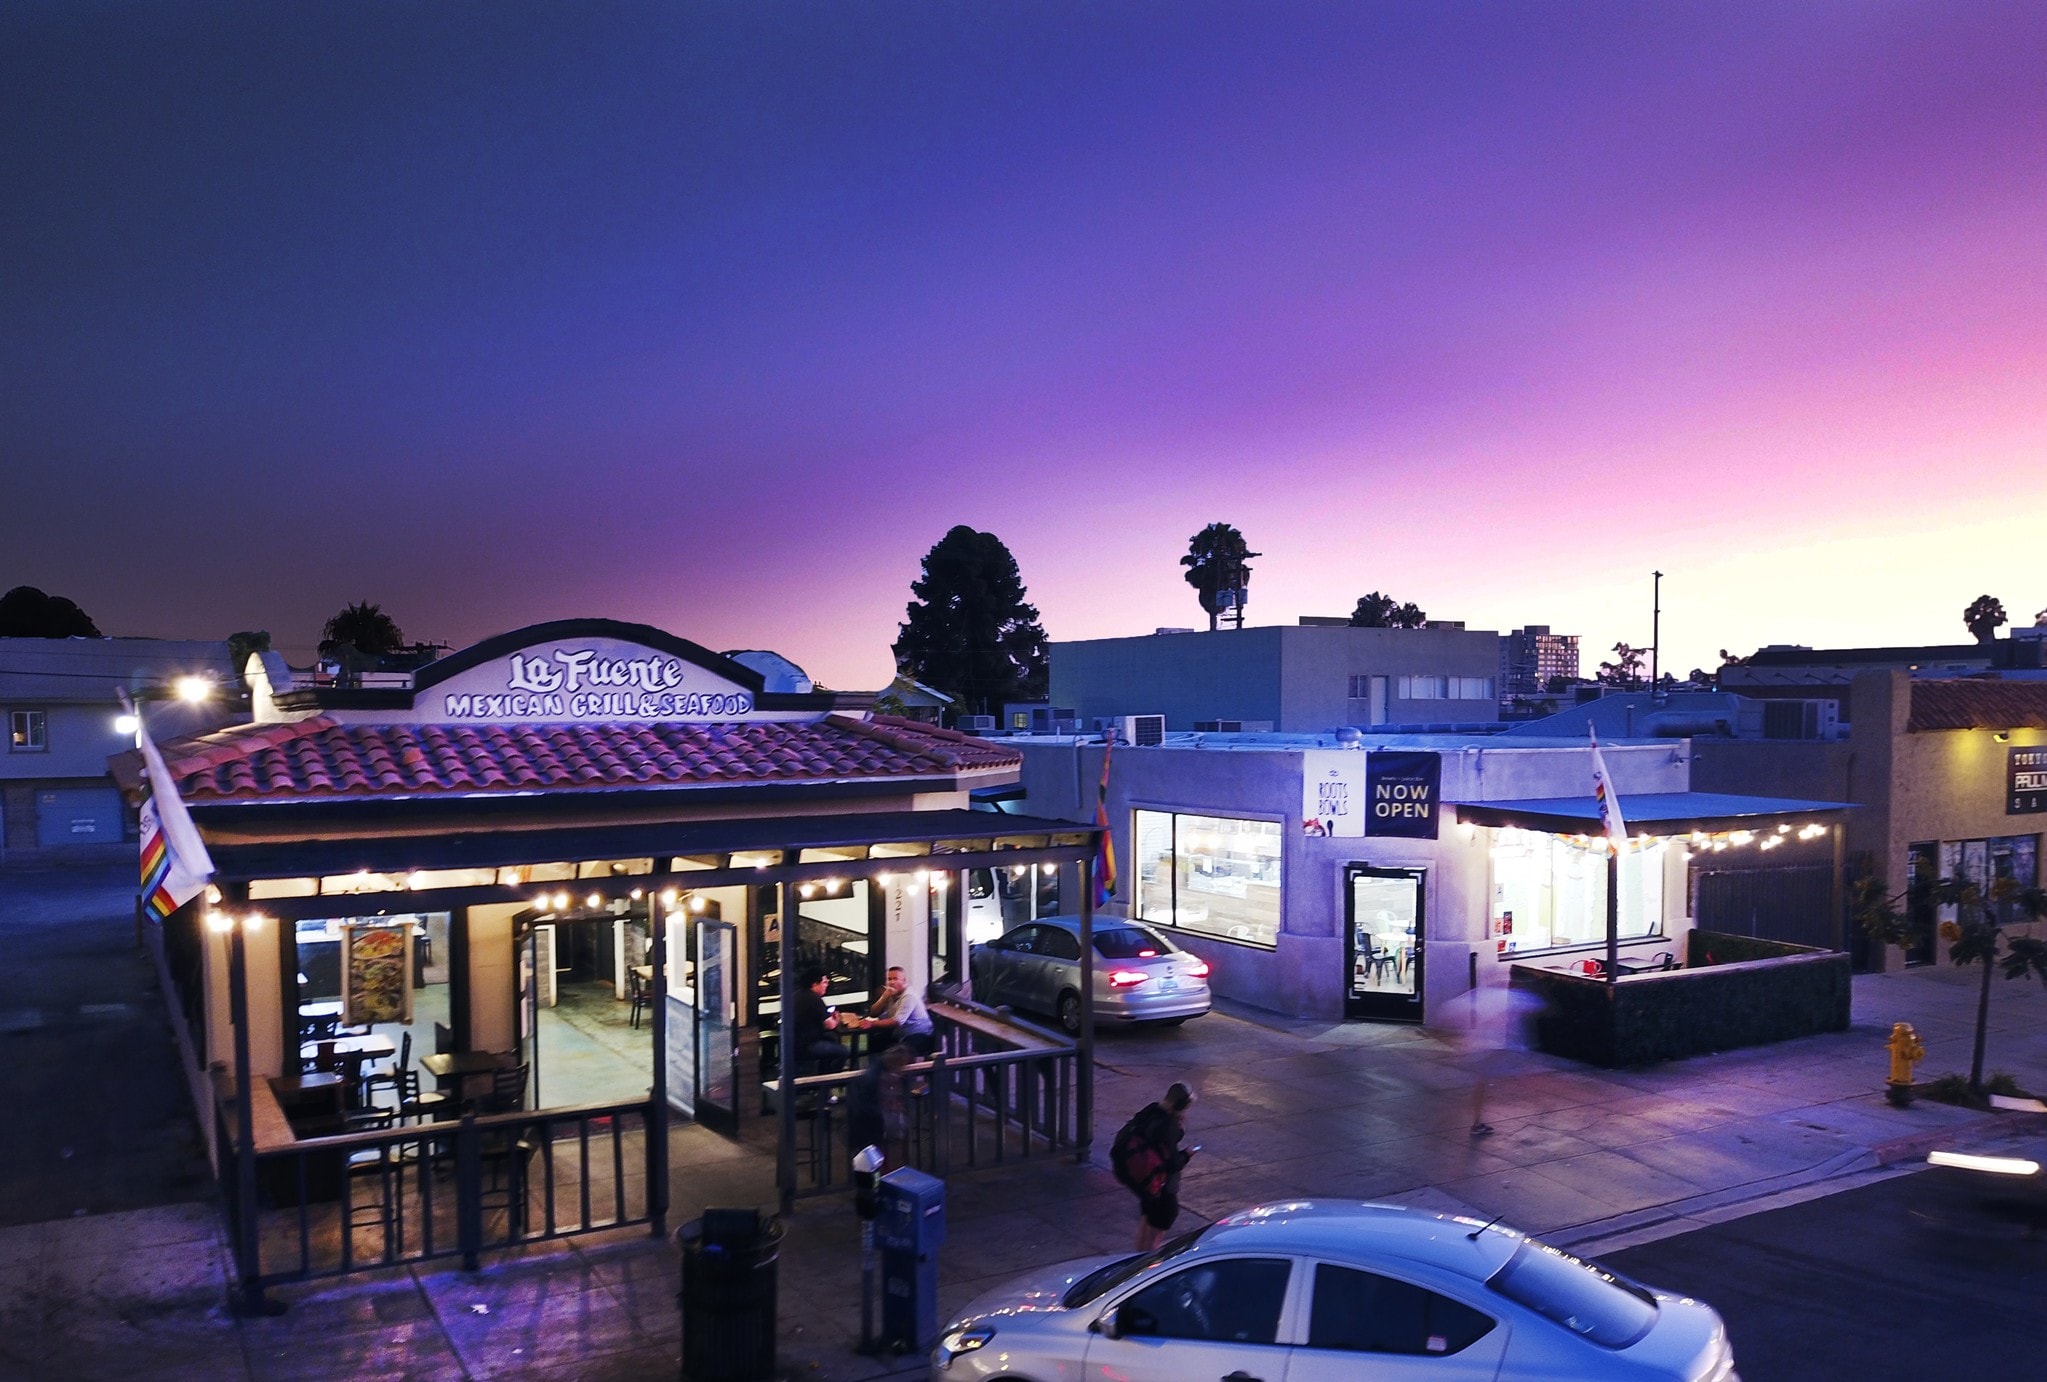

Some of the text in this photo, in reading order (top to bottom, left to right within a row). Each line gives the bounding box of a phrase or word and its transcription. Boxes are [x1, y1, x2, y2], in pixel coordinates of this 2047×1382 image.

[507, 649, 683, 693] La Fuente
[445, 693, 564, 718] MEXICAN
[1376, 784, 1429, 800] NOW
[1375, 802, 1429, 818] OPEN
